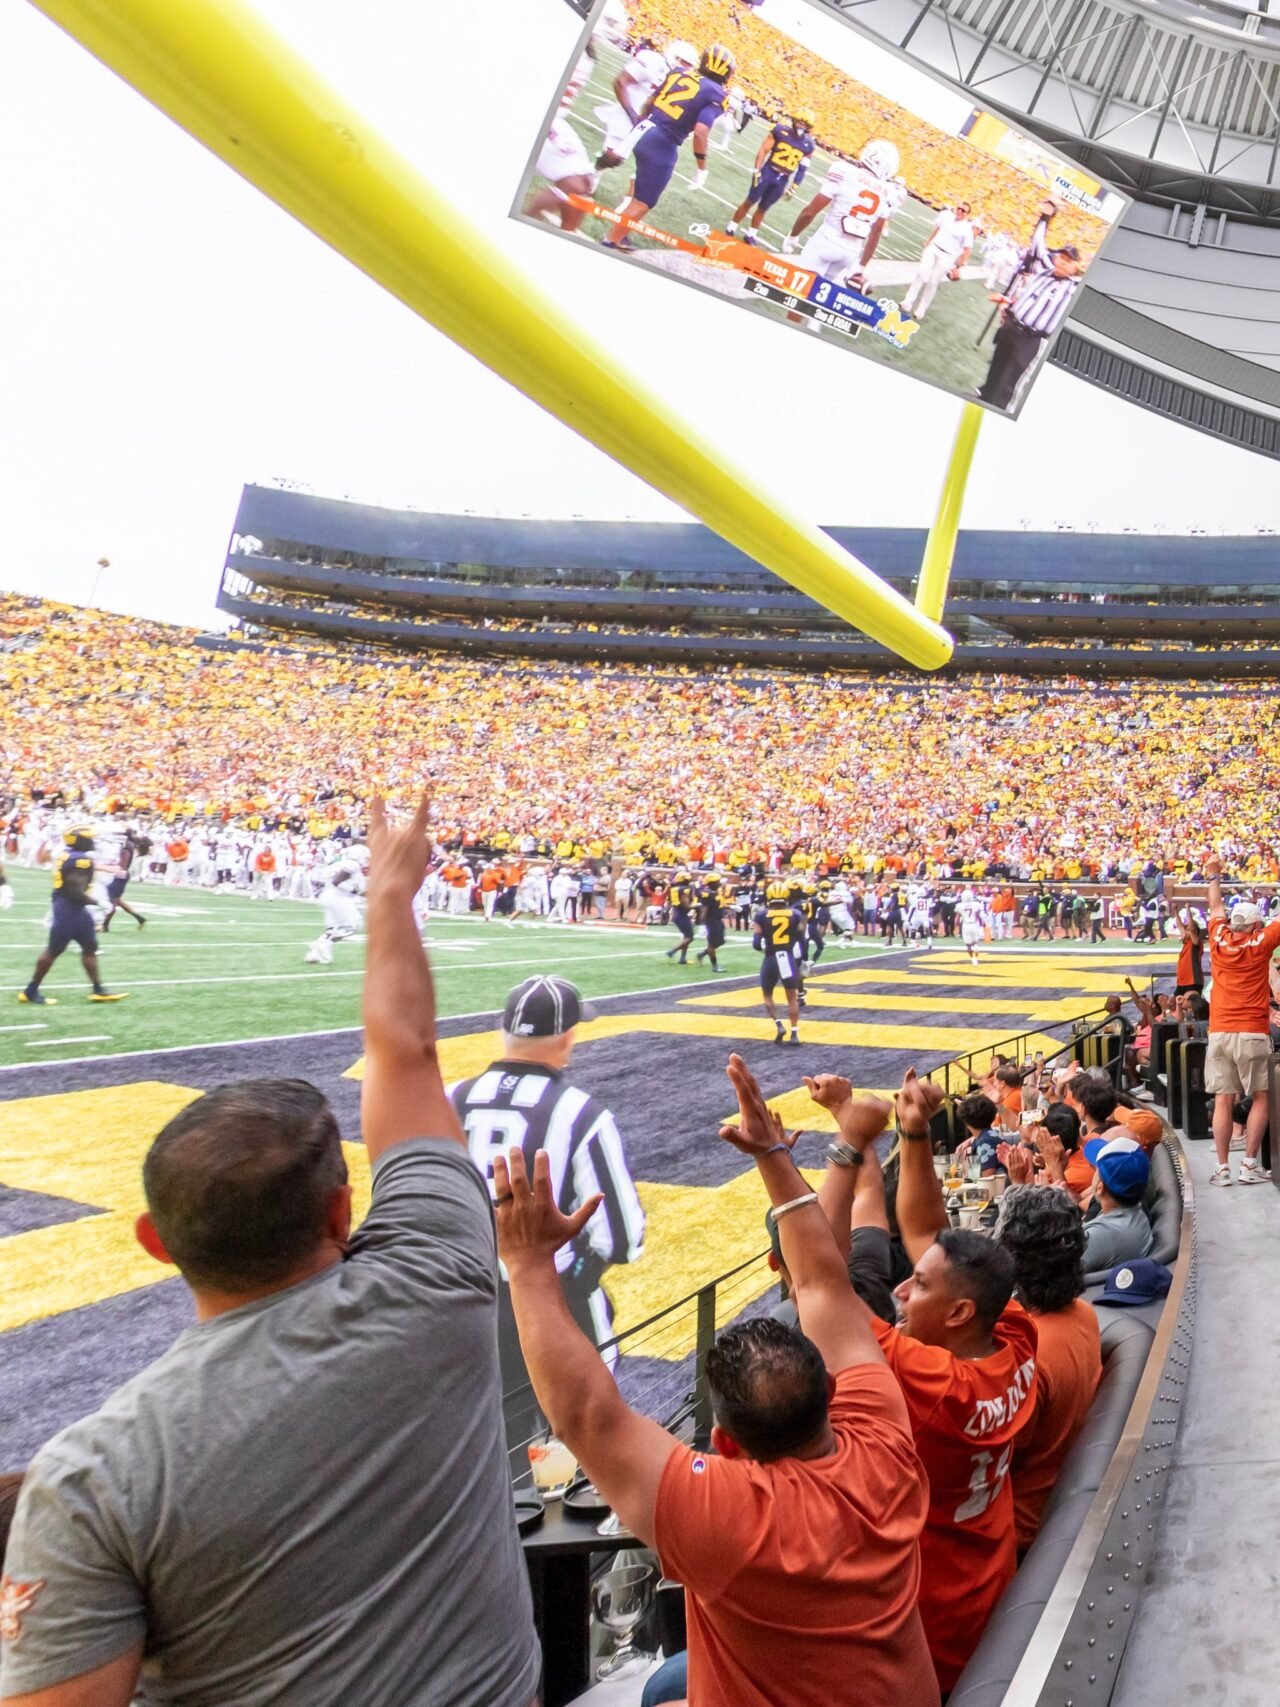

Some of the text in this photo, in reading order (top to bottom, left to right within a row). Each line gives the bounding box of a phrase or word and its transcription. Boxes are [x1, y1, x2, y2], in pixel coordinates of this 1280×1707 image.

[653, 73, 700, 120] 12
[850, 189, 881, 223] 2
[763, 260, 788, 279] TEXAS
[790, 271, 810, 292] 17
[815, 282, 832, 303] 3
[836, 292, 874, 316] MICHIGAN
[877, 309, 920, 346] M
[772, 917, 790, 945] 2
